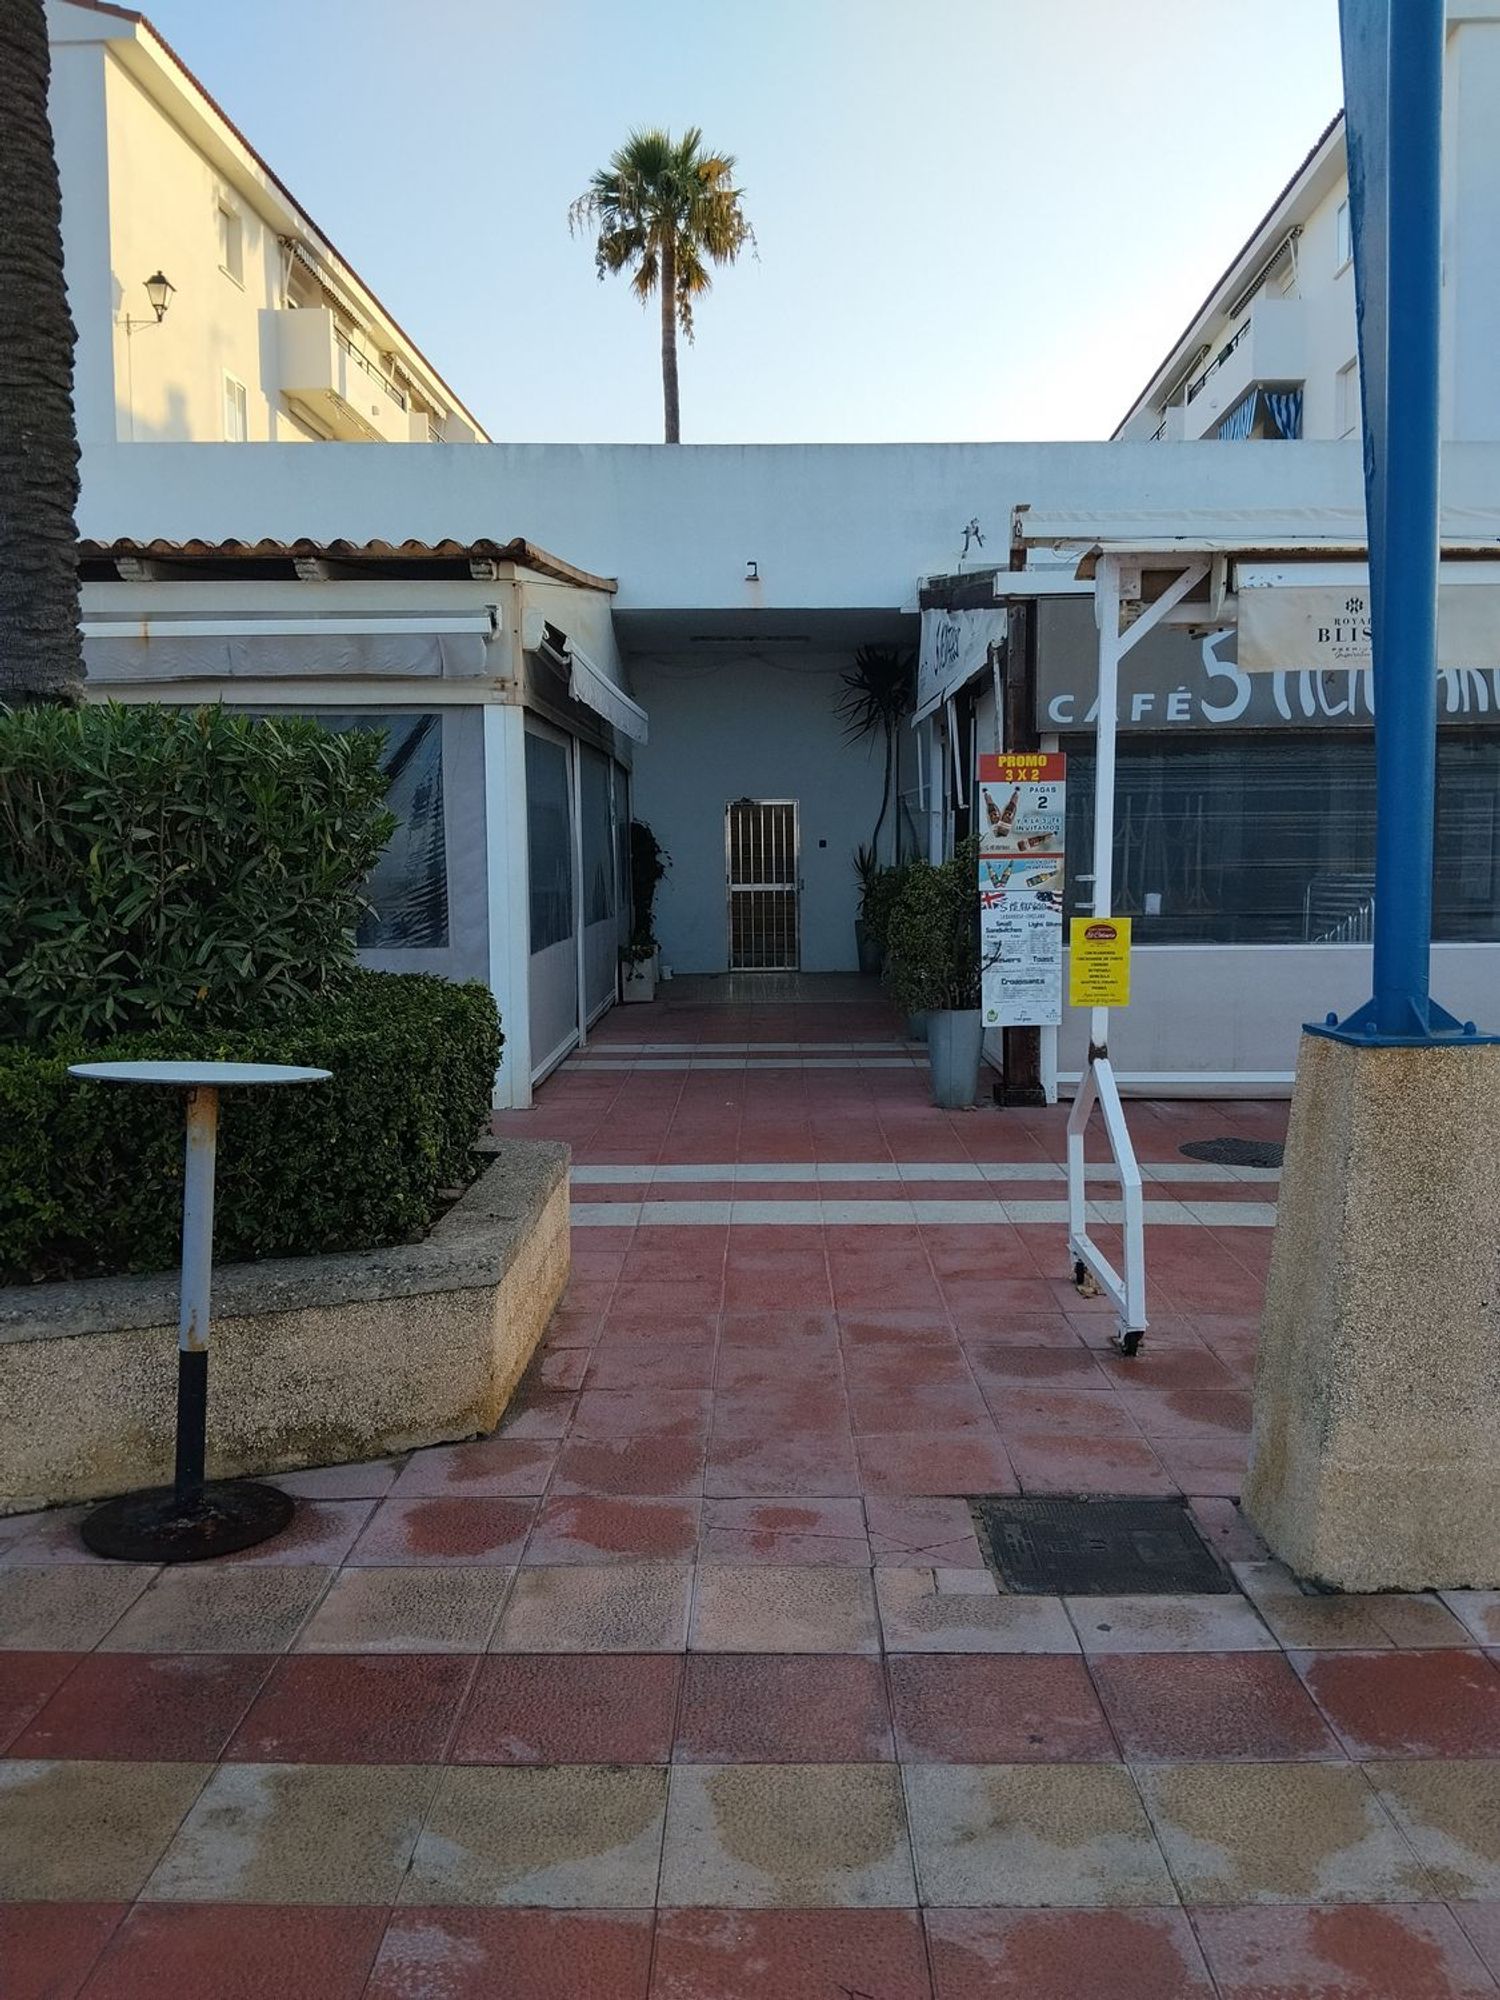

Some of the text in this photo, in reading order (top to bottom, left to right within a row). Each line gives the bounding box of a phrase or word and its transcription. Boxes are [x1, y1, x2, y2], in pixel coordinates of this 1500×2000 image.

[1318, 627, 1373, 643] BLIS
[998, 755, 1047, 767] PROMO
[1005, 769, 1014, 781] 3
[1031, 769, 1040, 781] 2
[1029, 786, 1057, 794] PAGAS
[1037, 796, 1048, 809] 2
